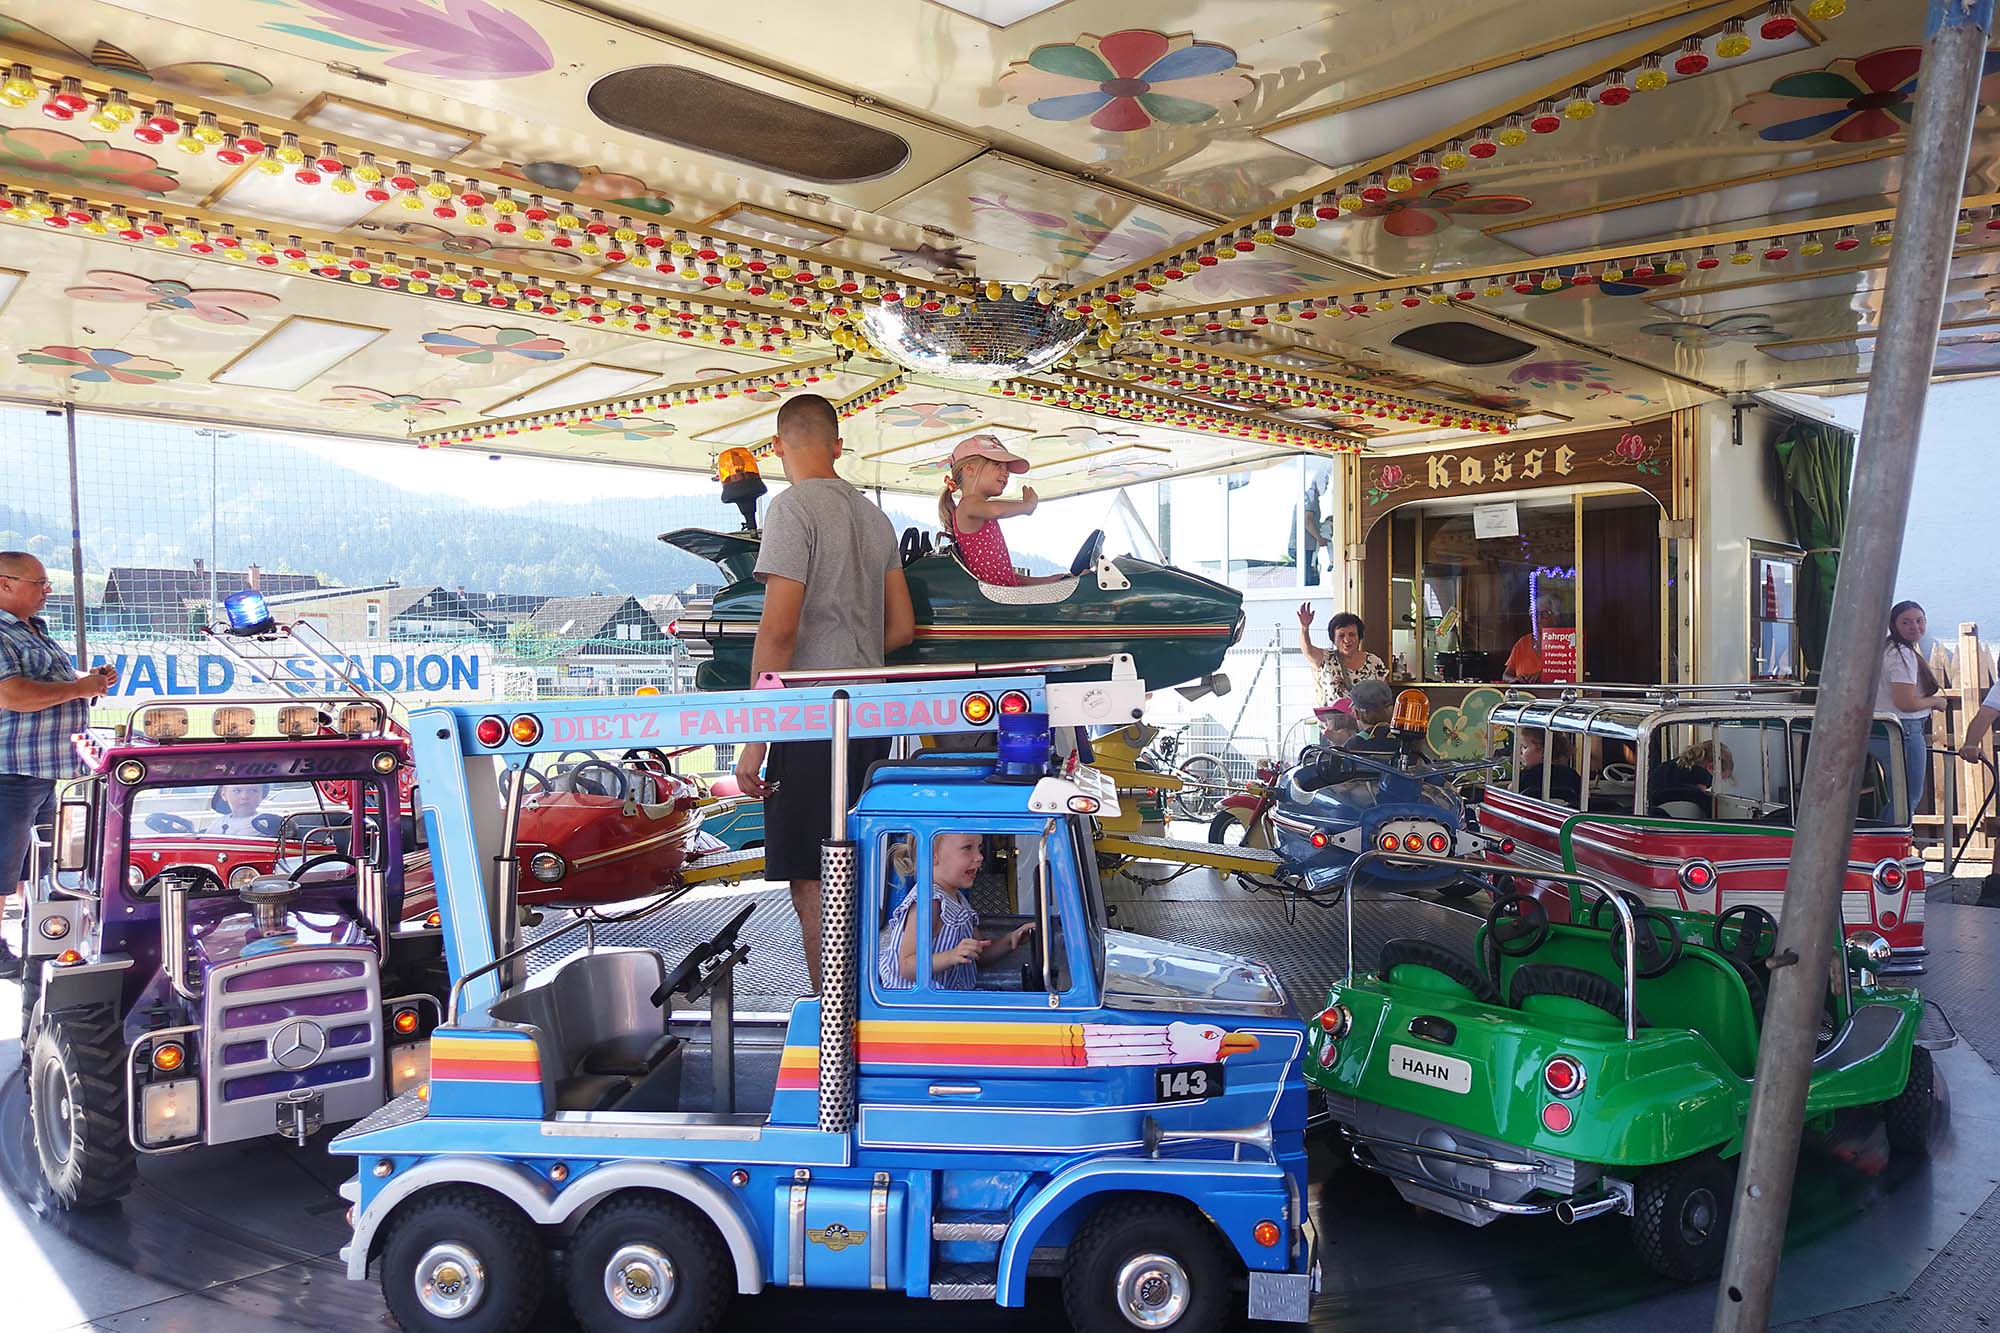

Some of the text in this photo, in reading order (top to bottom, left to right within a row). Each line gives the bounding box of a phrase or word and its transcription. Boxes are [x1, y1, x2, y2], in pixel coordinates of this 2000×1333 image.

[1426, 444, 1576, 490] Kasse
[285, 654, 479, 692] STADION
[550, 700, 957, 743] DIETZ FAHRZEGBAU
[288, 757, 355, 775] 1300
[1160, 1070, 1208, 1098] 143
[1402, 1057, 1449, 1081] HAHN
